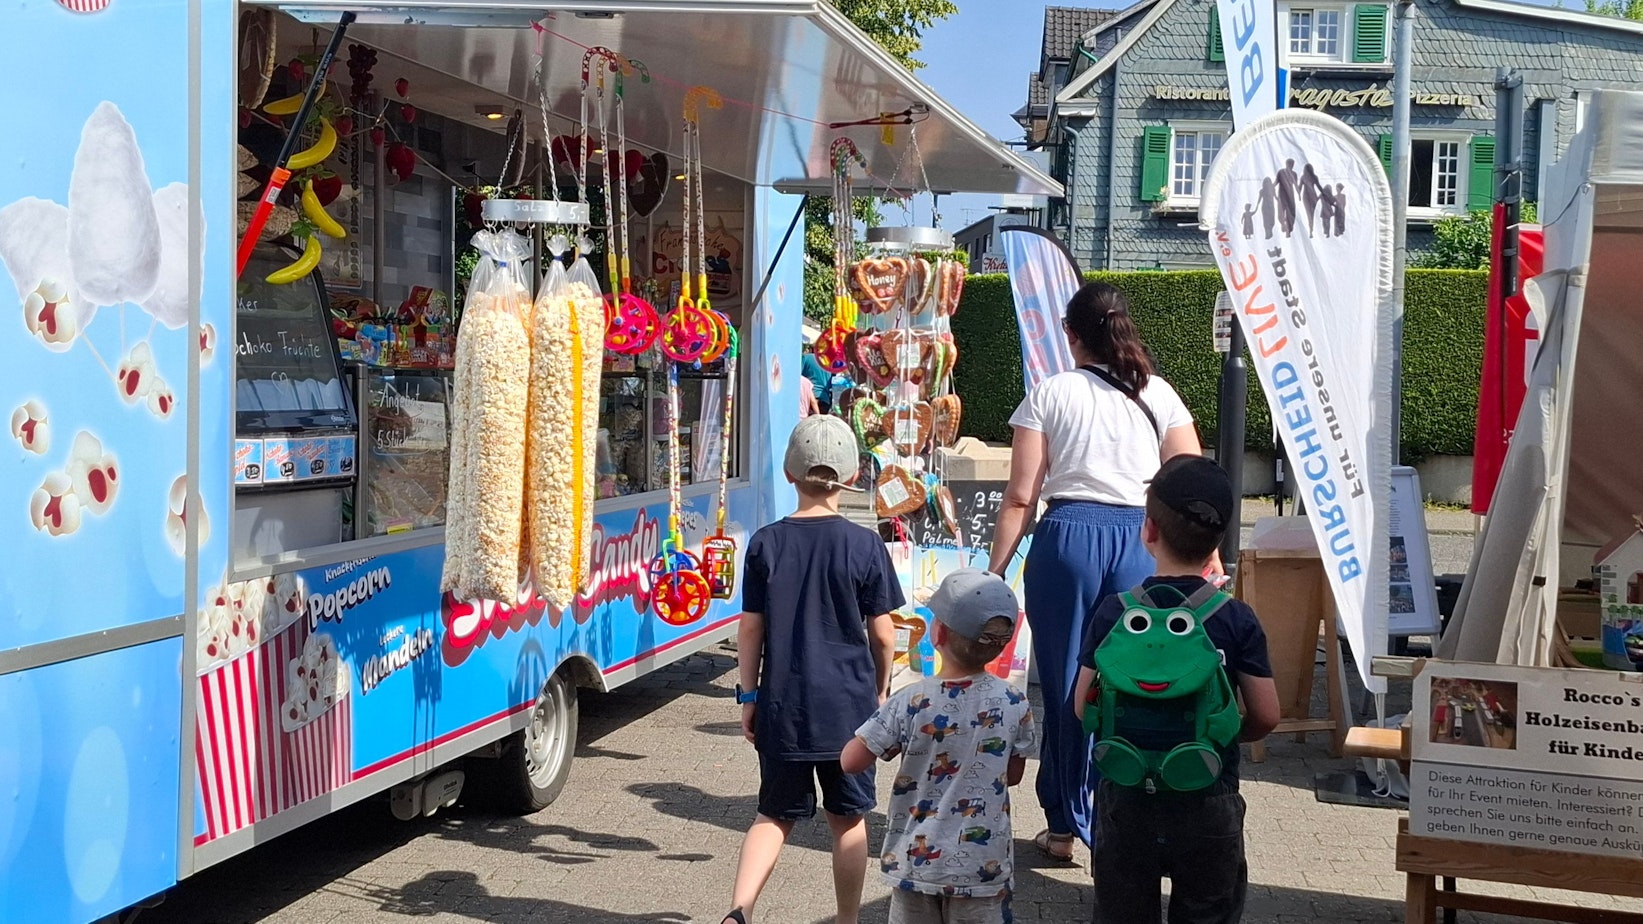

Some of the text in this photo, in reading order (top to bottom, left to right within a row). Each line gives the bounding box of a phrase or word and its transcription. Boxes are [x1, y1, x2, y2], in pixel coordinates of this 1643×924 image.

[1231, 0, 1264, 109] BE
[1156, 84, 1231, 101] Ristorant
[1289, 82, 1394, 111] ragosta
[866, 273, 897, 288] Honey
[307, 565, 392, 632] Popcorn
[361, 626, 433, 695] Mandeln
[1548, 740, 1579, 756] für
[1428, 771, 1462, 784] Diese
[1466, 774, 1526, 790] Attraktion
[1530, 779, 1547, 792] für
[1551, 782, 1593, 796] Kinder
[1428, 785, 1445, 798] für
[1448, 788, 1465, 800] Ihr
[1469, 790, 1502, 804] Event
[1506, 795, 1553, 809] mieten.
[1557, 799, 1633, 817] Interessiert?
[1427, 805, 1639, 834] sprechen Sie uns bitte einfach an.
[1427, 820, 1465, 833] geben
[1470, 822, 1504, 837] Ihnen
[1508, 830, 1545, 841] gerne
[1549, 833, 1597, 847] genaue
